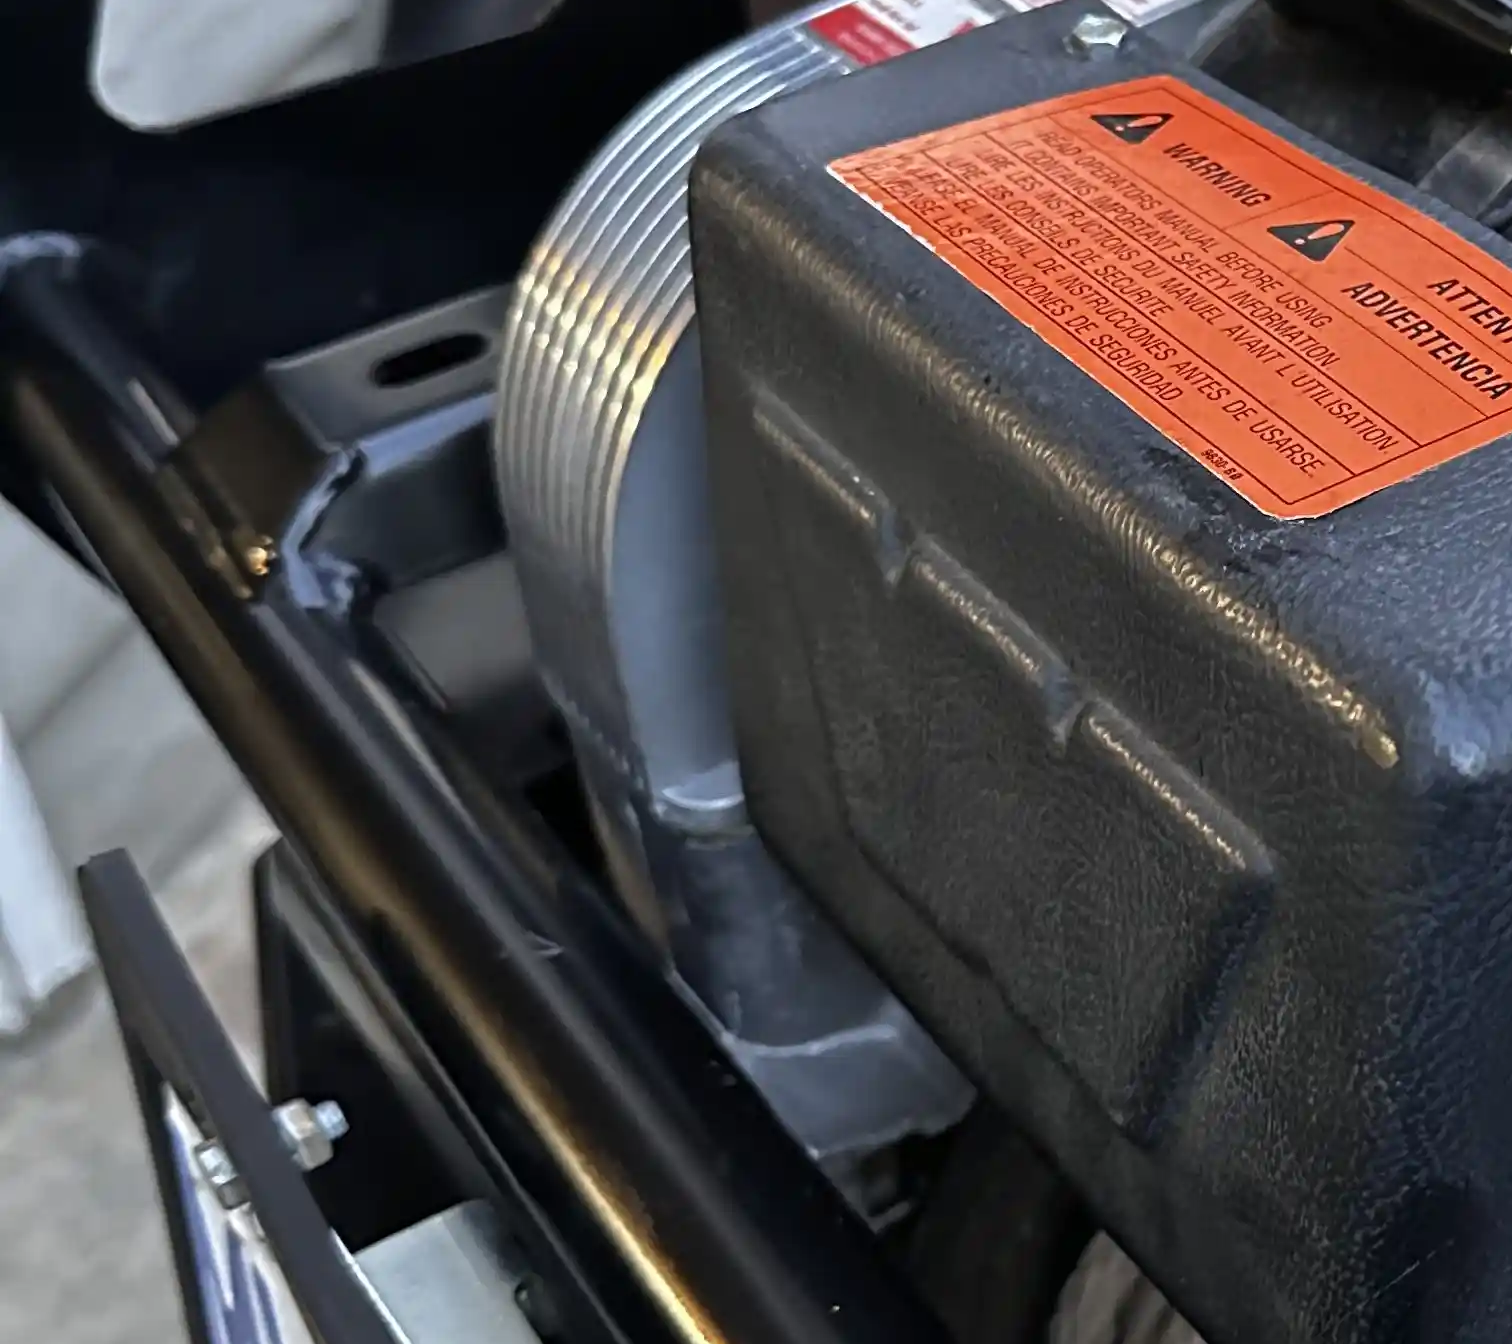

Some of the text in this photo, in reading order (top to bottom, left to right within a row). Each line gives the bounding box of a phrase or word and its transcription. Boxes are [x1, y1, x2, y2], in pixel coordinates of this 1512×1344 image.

[945, 158, 988, 181] LIRE
[976, 179, 1014, 201] LES
[1004, 199, 1080, 249] CONSEILS
[1069, 247, 1104, 266] DE
[1008, 139, 1034, 151] IT
[1023, 149, 1100, 197] CONTAINS
[1090, 194, 1180, 251] IMPORTANT
[1170, 251, 1237, 290] SAFETY
[1036, 131, 1084, 156] READ
[1073, 155, 1162, 211] OPERATORS
[1153, 208, 1218, 253] MANUAL
[1215, 251, 1284, 292] BEFORE
[1163, 142, 1271, 207] WARNING
[878, 176, 945, 216] VEANSE
[932, 214, 973, 237] LAS
[961, 236, 1074, 316] PRECAUCIONES
[1064, 314, 1099, 335] DE
[952, 197, 977, 214] EL
[974, 212, 1038, 259] MANUAL
[1032, 257, 1066, 275] DE
[1055, 274, 1177, 360] INSTRUCCIONES
[1168, 360, 1231, 400] ANTES
[1221, 399, 1258, 421] DE
[1004, 170, 1044, 192] LES
[1130, 259, 1166, 278] DU
[1157, 277, 1225, 325] MANUEL
[1221, 325, 1286, 363] AVANT
